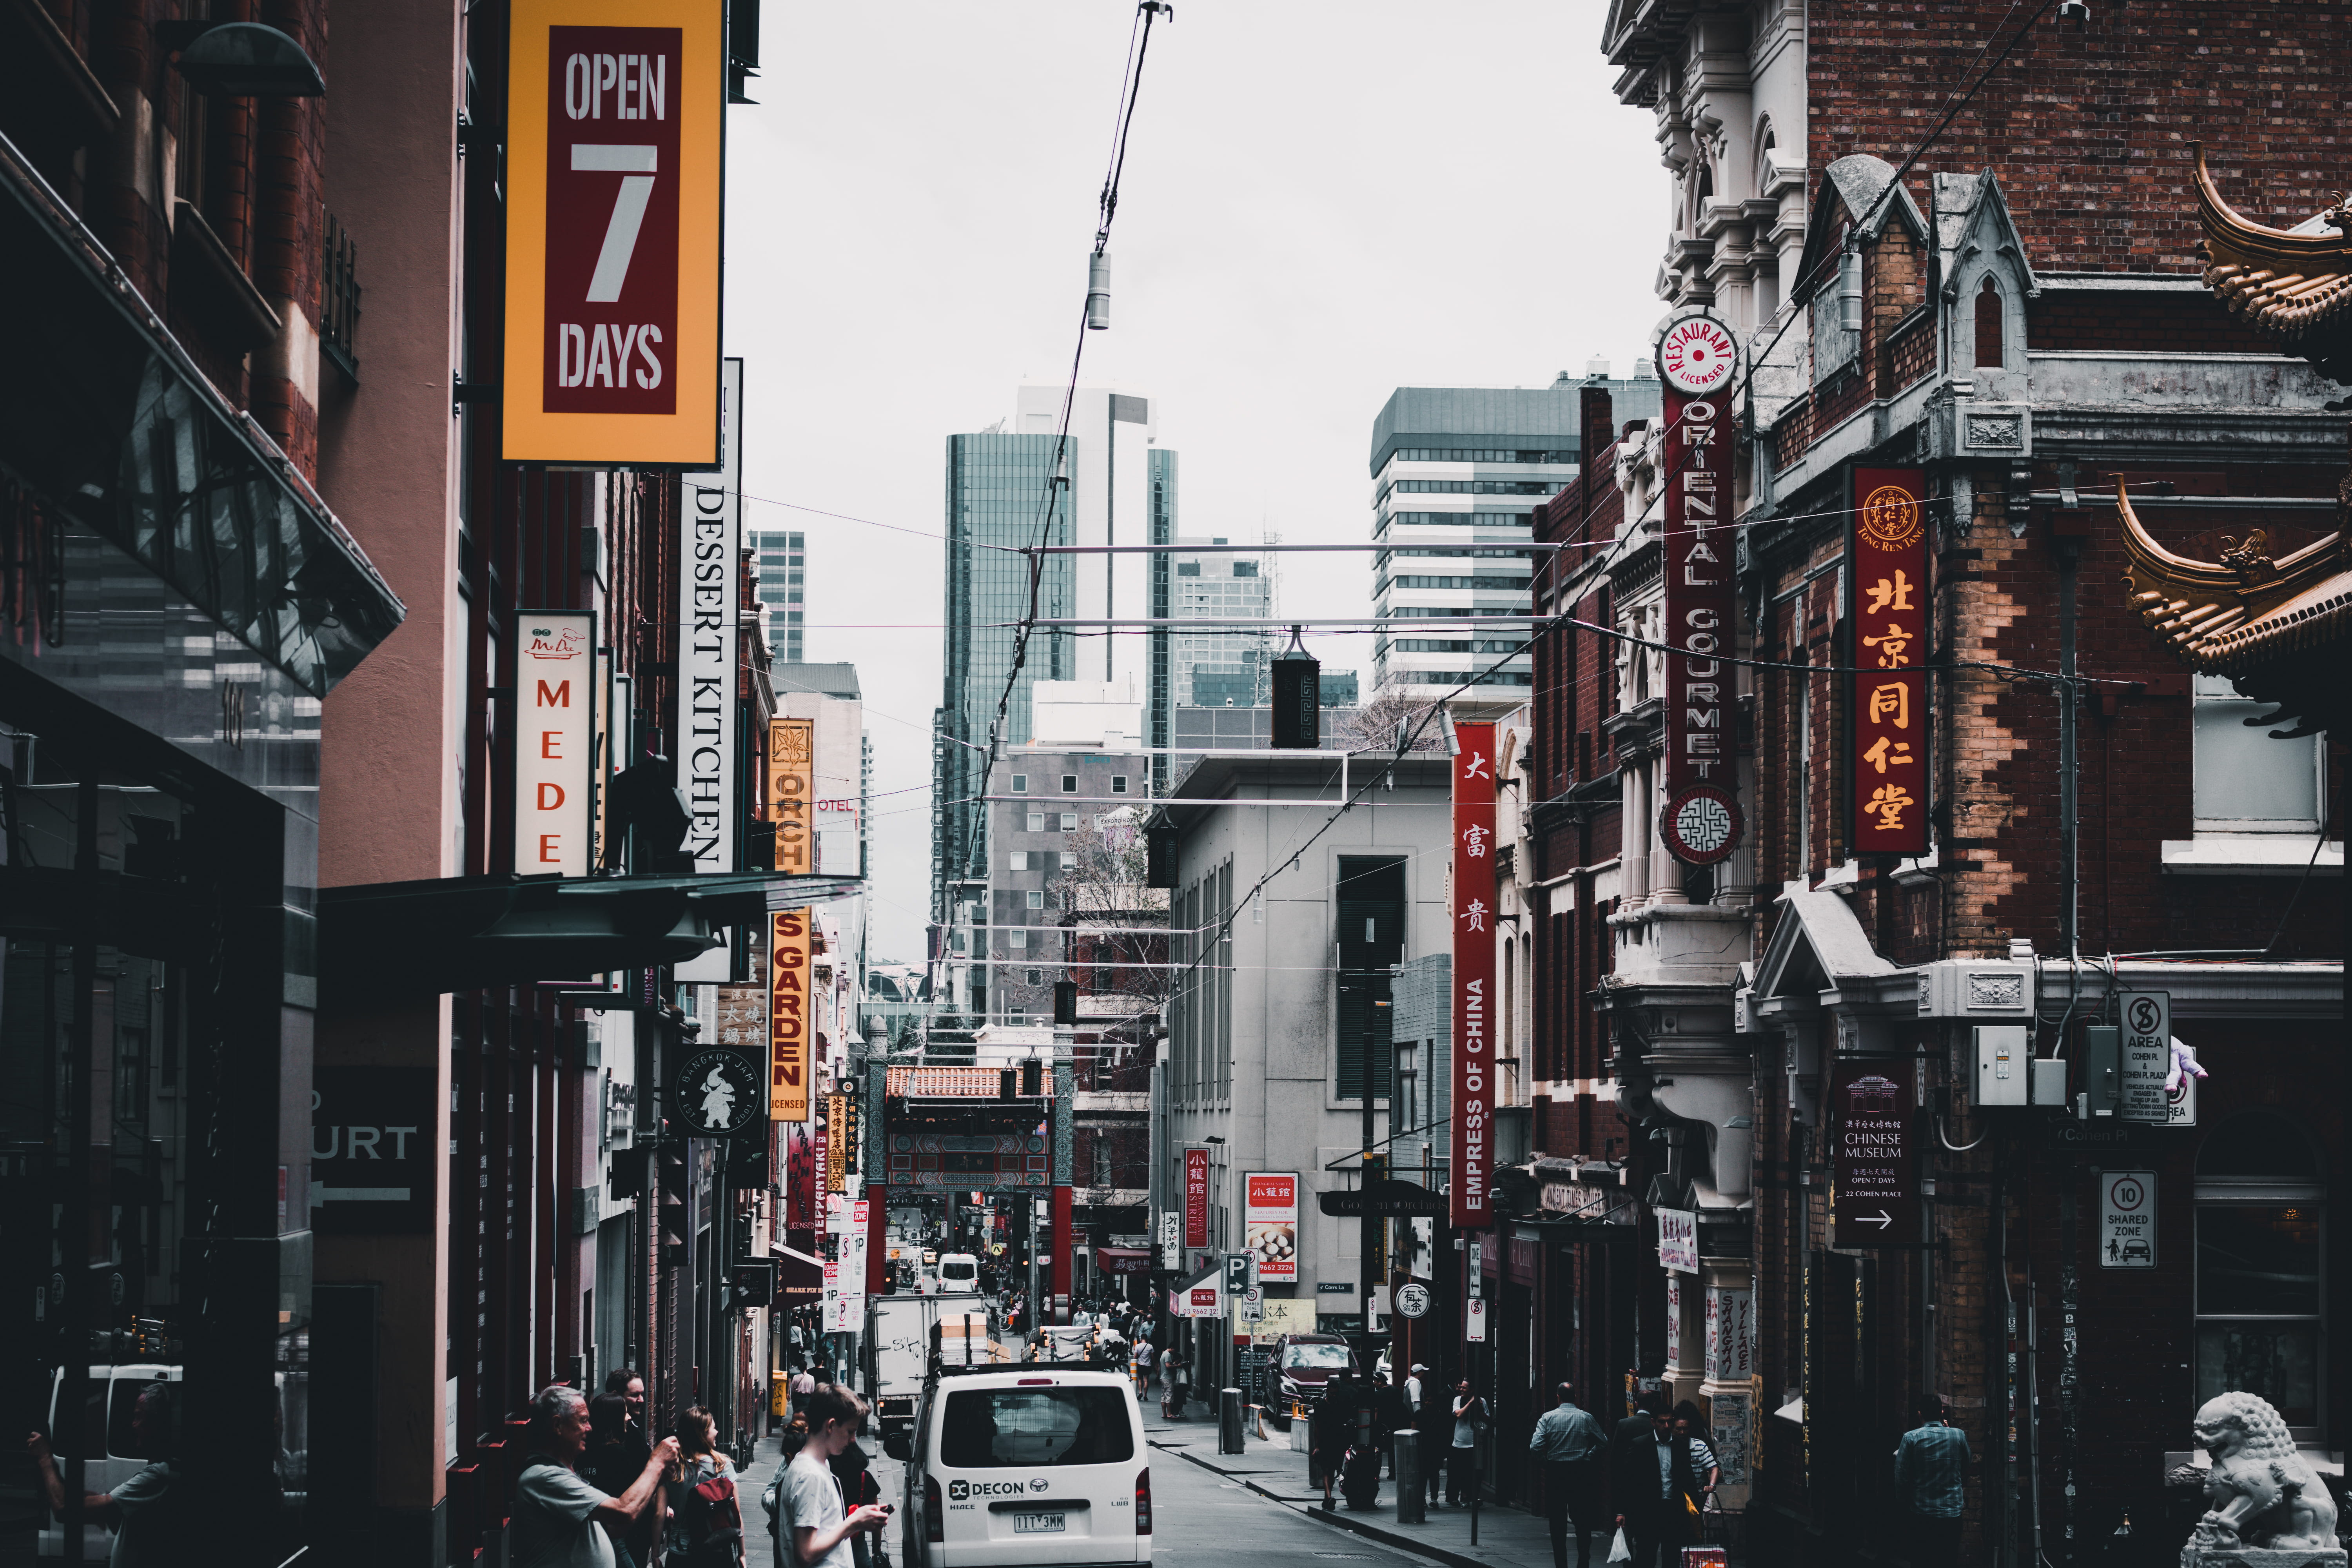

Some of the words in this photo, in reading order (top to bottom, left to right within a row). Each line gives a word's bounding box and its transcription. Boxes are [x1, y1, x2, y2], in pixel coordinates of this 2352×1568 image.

[565, 53, 665, 120] OPEN
[571, 144, 657, 302] 7
[559, 323, 663, 390] DAYS
[1666, 323, 1732, 372] RESTAURANT
[1680, 364, 1724, 384] LICENSED
[1682, 401, 1719, 585] ORIENTAL
[1884, 496, 1896, 535] 同仁堂
[694, 486, 724, 663] DESSERT
[1686, 608, 1719, 778] GOURMET
[1863, 570, 1914, 830] 北京同仁堂
[691, 676, 722, 863] KITCHEN
[773, 946, 803, 1086] GARDEN
[1466, 978, 1483, 1053] CHINA
[2128, 1036, 2163, 1048] AREA
[682, 1053, 730, 1082] BANGKOK
[735, 1061, 754, 1082] JAM
[1466, 1061, 1483, 1091] OF
[683, 1103, 696, 1121] EST.
[735, 1104, 753, 1123] 2001
[1845, 1133, 1901, 1144] CHINESE
[2065, 1128, 2110, 1142] Cohen
[2116, 1129, 2128, 1142] Pl
[1466, 1099, 1483, 1209] EMPRESS
[1846, 1147, 1901, 1158] MUSEUM
[833, 1159, 841, 1190] RESTAURANT
[1189, 1154, 1206, 1194] 小籠館
[815, 1147, 826, 1237] TEPPANYAKI
[1253, 1187, 1290, 1197] 小籠館
[1583, 1191, 1601, 1214] HOUSE
[2121, 1187, 2136, 1203] 10
[1341, 1199, 1388, 1210] Golen
[1397, 1199, 1448, 1210] Orchids
[2108, 1215, 2148, 1224] SHARED
[2115, 1227, 2141, 1236] ZONE
[855, 1238, 864, 1252] 1P
[1230, 1258, 1245, 1276] P
[1661, 1247, 1680, 1264] SHANGHAI
[1681, 1250, 1697, 1268] VILLAGE
[1471, 1265, 1480, 1277] WAY
[826, 1290, 838, 1301] 1P
[1722, 1296, 1733, 1374] SHANGHAI
[1737, 1300, 1748, 1371] VILLAGE
[1706, 1357, 1717, 1374] B.Y.O.
[973, 1483, 1024, 1495] DECON
[1017, 1517, 1035, 1528] 1IT
[1044, 1515, 1063, 1528] 3MM
